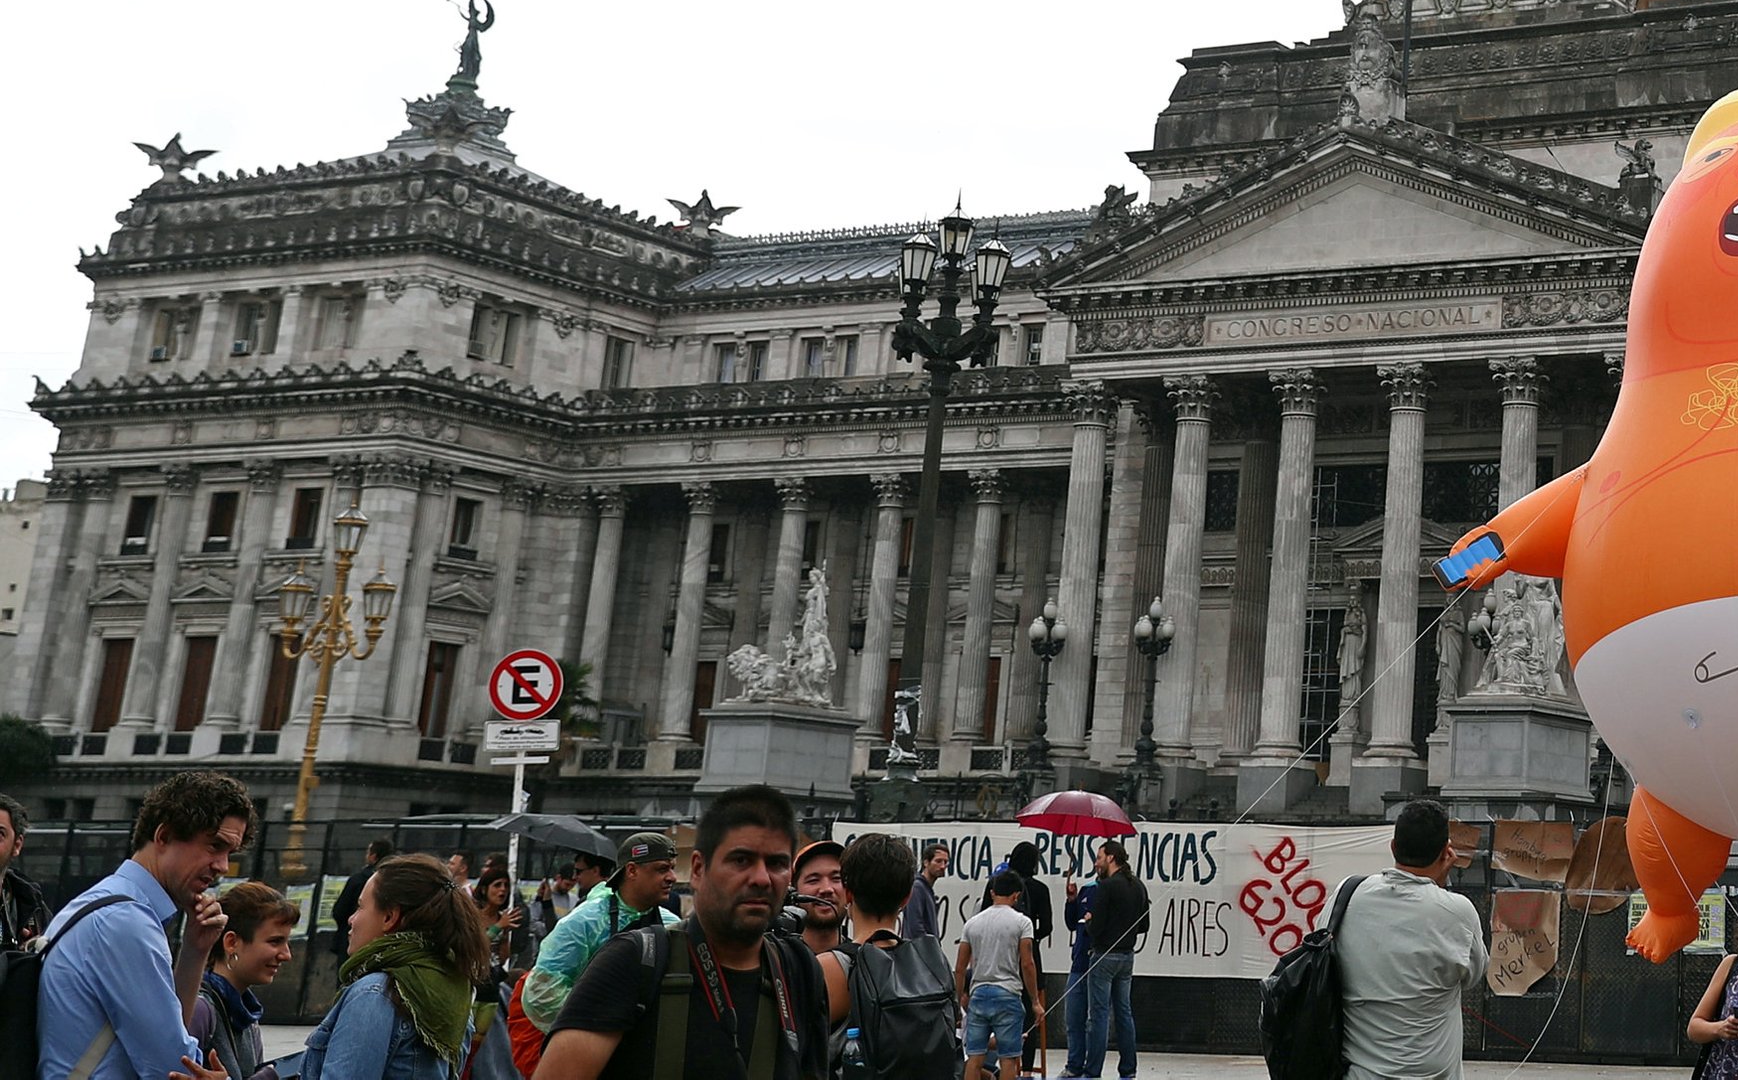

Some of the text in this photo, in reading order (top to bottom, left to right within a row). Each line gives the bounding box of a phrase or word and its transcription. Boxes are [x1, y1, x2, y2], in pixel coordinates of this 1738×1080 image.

[1226, 306, 1480, 340] CONGRESO NACIONAL
[511, 665, 541, 705] E
[1158, 898, 1232, 957] AIRES
[1238, 879, 1304, 957] G20
[696, 942, 715, 971] EOS
[707, 971, 720, 987] 5D
[775, 978, 789, 1019] Canon
